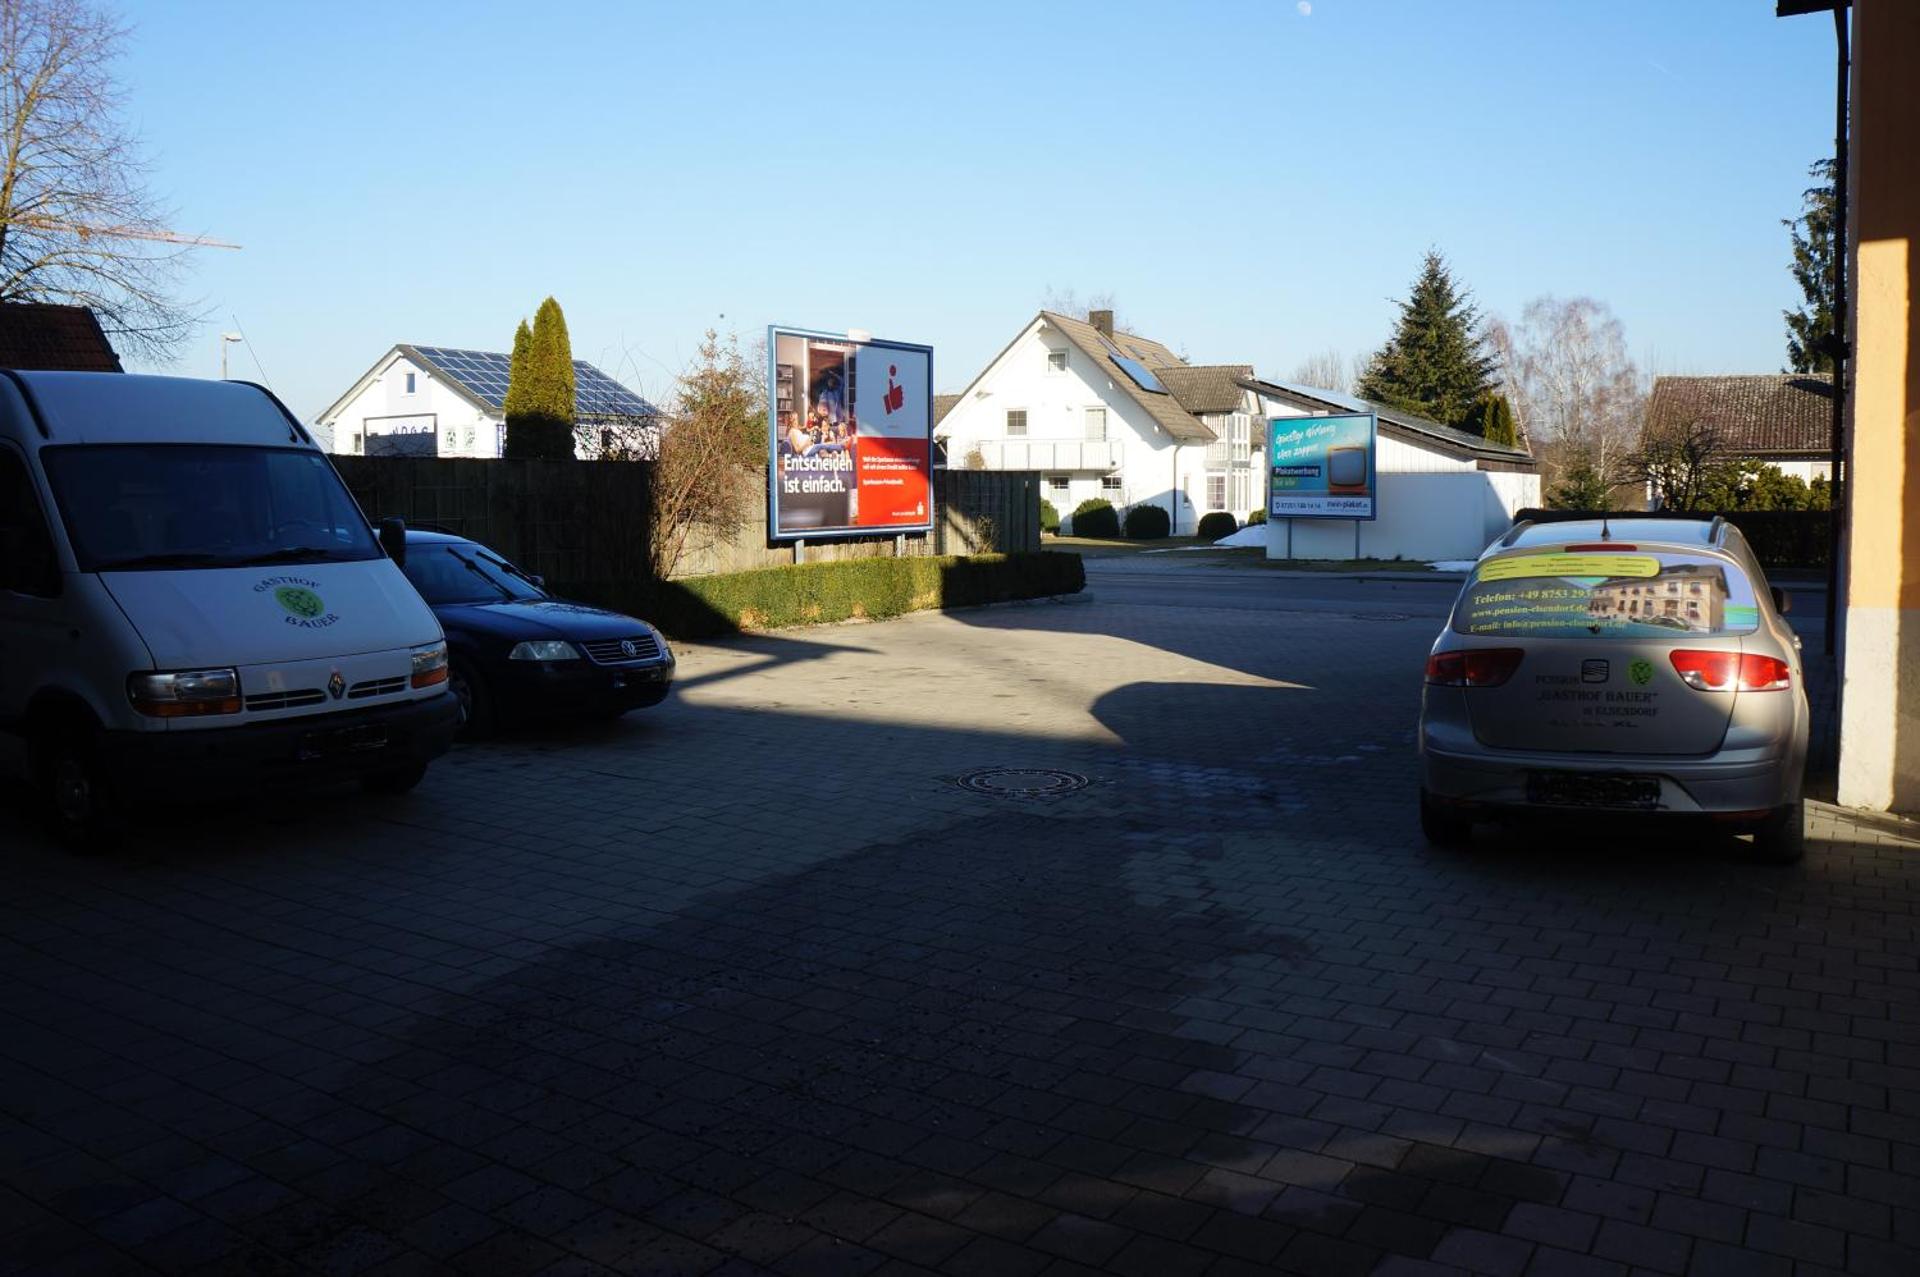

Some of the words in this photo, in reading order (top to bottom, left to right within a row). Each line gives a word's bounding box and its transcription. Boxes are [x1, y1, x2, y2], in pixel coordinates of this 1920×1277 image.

[784, 453, 853, 472] Entscheiden
[784, 475, 800, 494] ist
[802, 474, 846, 494] einfach.
[253, 576, 322, 592] GASTHOF
[1474, 593, 1515, 605] Telefon:
[285, 613, 341, 629] BAUER
